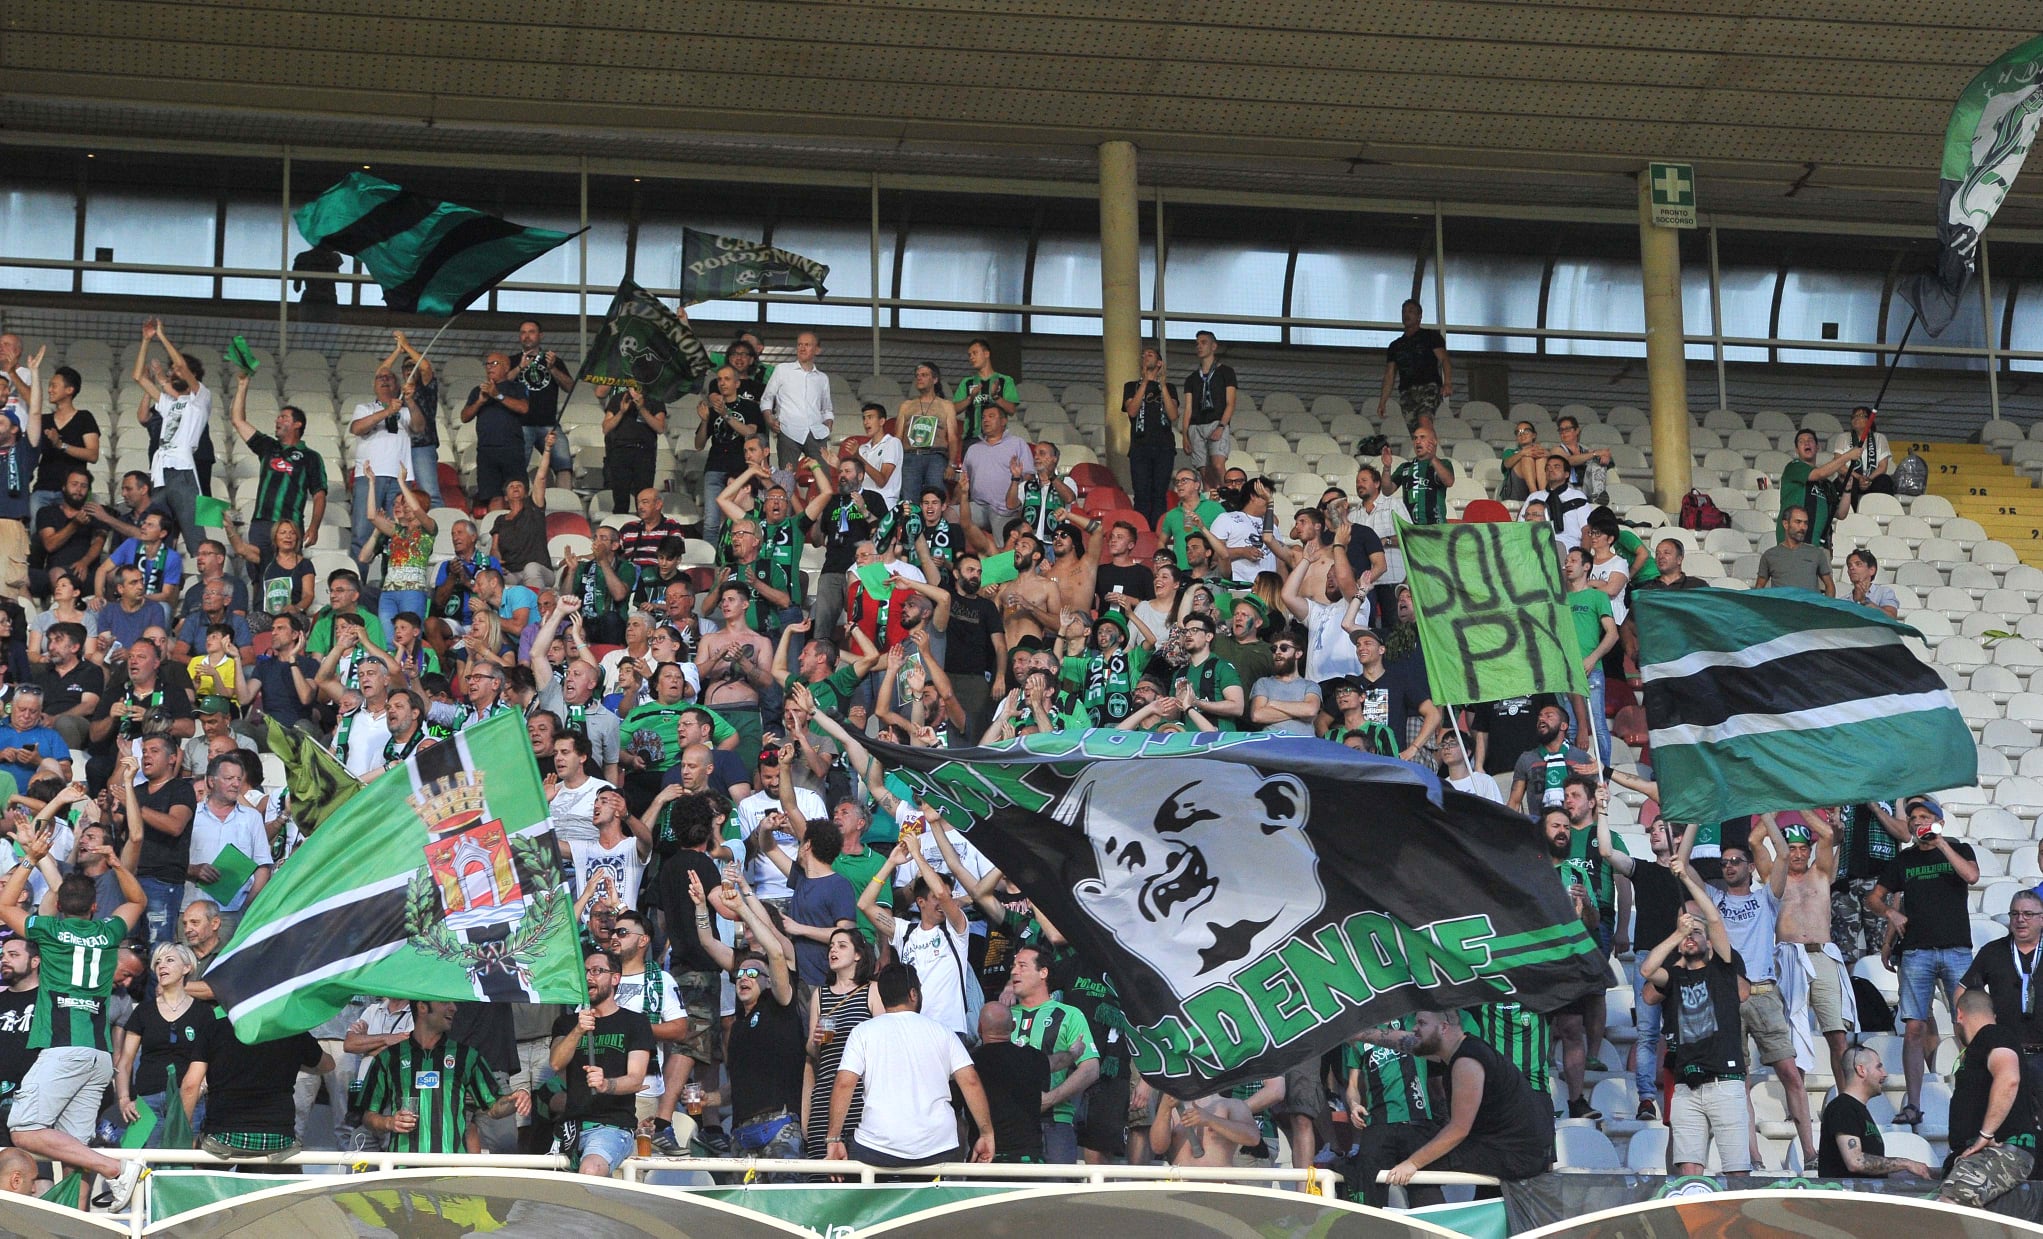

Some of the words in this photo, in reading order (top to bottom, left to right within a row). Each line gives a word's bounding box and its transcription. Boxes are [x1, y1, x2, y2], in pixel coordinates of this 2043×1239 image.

[1660, 208, 1688, 217] PRONTO
[1655, 216, 1694, 225] SOCCORSO
[1912, 443, 1930, 452] 28
[1940, 465, 1958, 475] 27
[1401, 522, 1568, 617] SOLO
[1452, 602, 1575, 701] PN
[1871, 843, 1892, 854] 1920
[71, 945, 102, 988] 11
